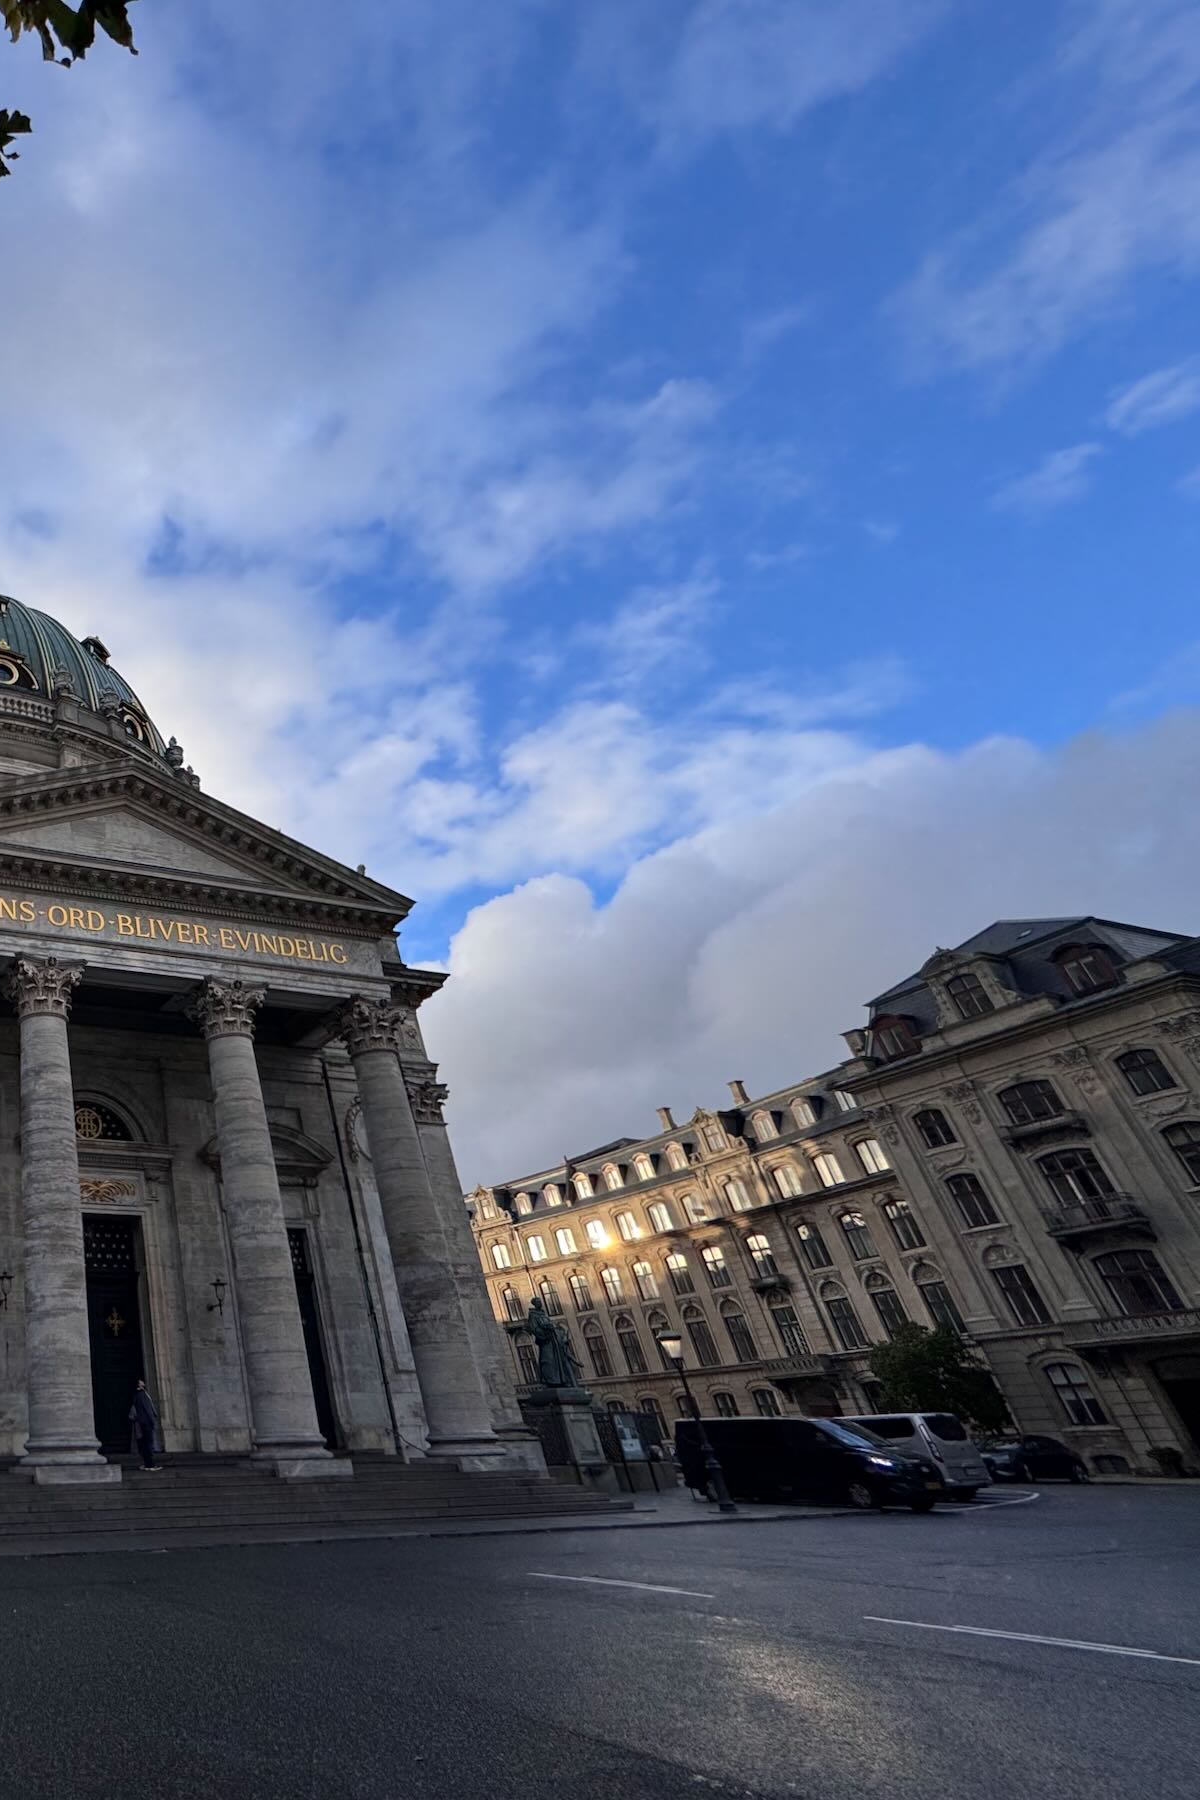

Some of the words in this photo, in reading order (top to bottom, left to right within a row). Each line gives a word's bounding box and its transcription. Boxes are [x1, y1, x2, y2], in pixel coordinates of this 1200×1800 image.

[46, 905, 106, 932] ORD
[116, 914, 211, 946] BLIVER
[217, 927, 348, 965] EVINDELIG
